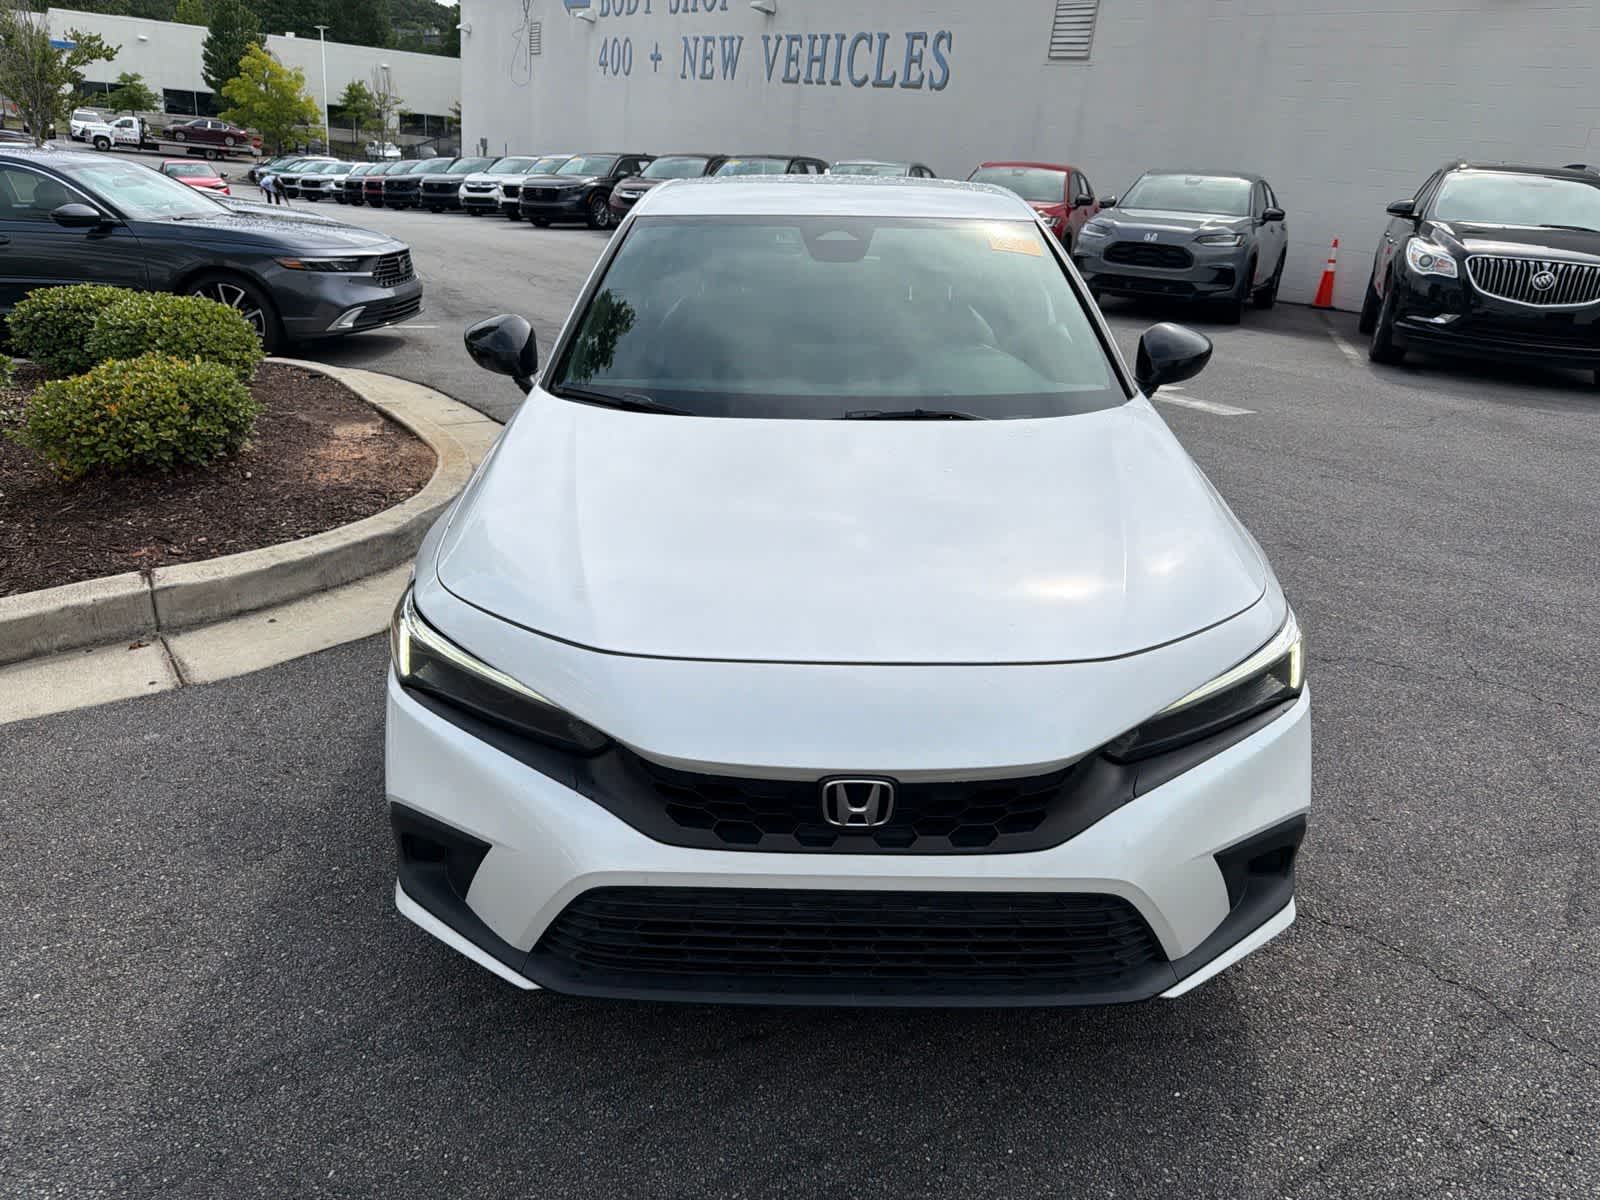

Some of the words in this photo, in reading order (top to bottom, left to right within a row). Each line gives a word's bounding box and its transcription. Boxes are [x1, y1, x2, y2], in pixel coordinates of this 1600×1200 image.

[599, 36, 633, 76] 400
[650, 41, 662, 72] +
[680, 35, 744, 81] NEW
[761, 30, 953, 91] VEHICLES
[836, 781, 881, 826] H
